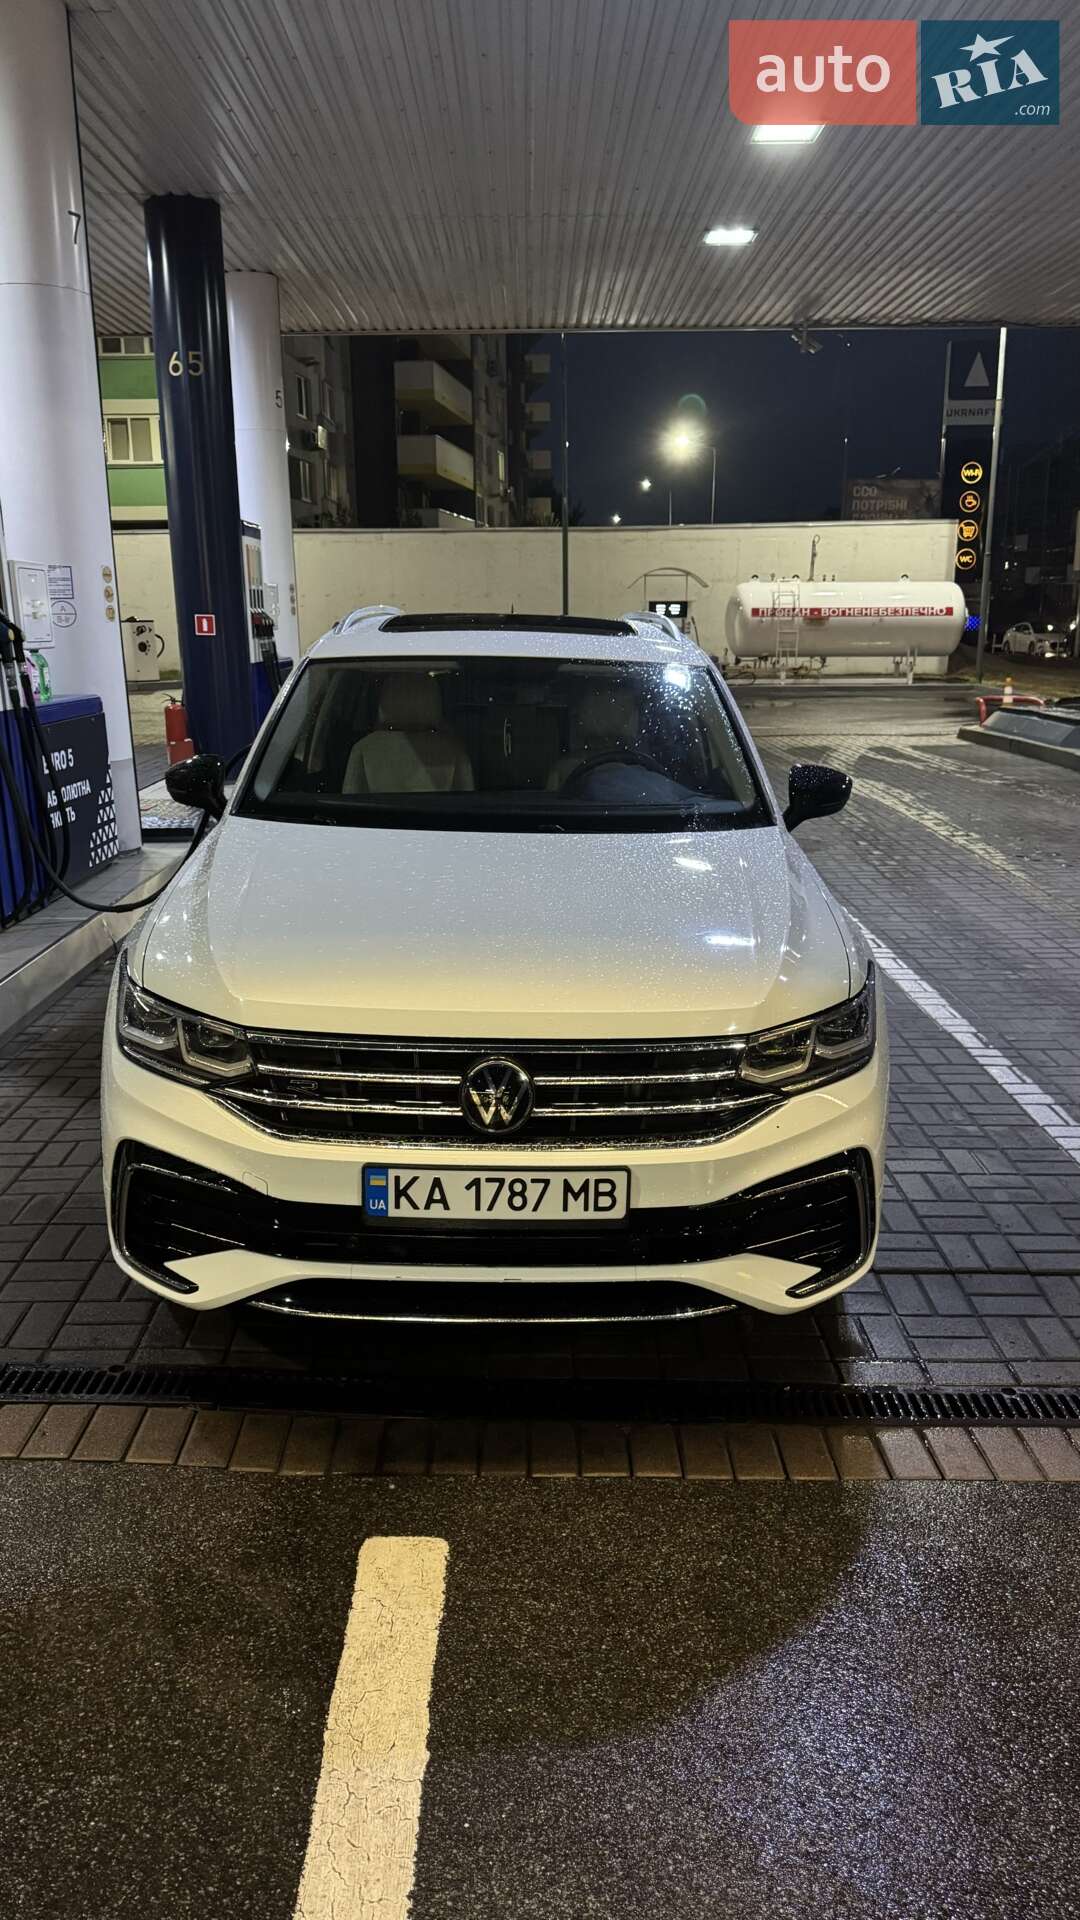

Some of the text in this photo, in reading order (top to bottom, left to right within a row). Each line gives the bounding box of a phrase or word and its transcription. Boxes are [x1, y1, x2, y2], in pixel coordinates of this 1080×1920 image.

[67, 210, 81, 245] 7
[275, 389, 283, 409] 5
[946, 407, 1003, 417] UKRNAF
[959, 555, 973, 563] WC
[821, 606, 946, 617] ВОГНЕНЕБЕЗПЕЧНО
[67, 748, 74, 767] 5
[47, 779, 92, 809] АБОЛЮТНА
[49, 806, 77, 829] ЯКІТЬ
[393, 1175, 617, 1213] KA 1787 MB
[369, 1199, 387, 1210] UA
